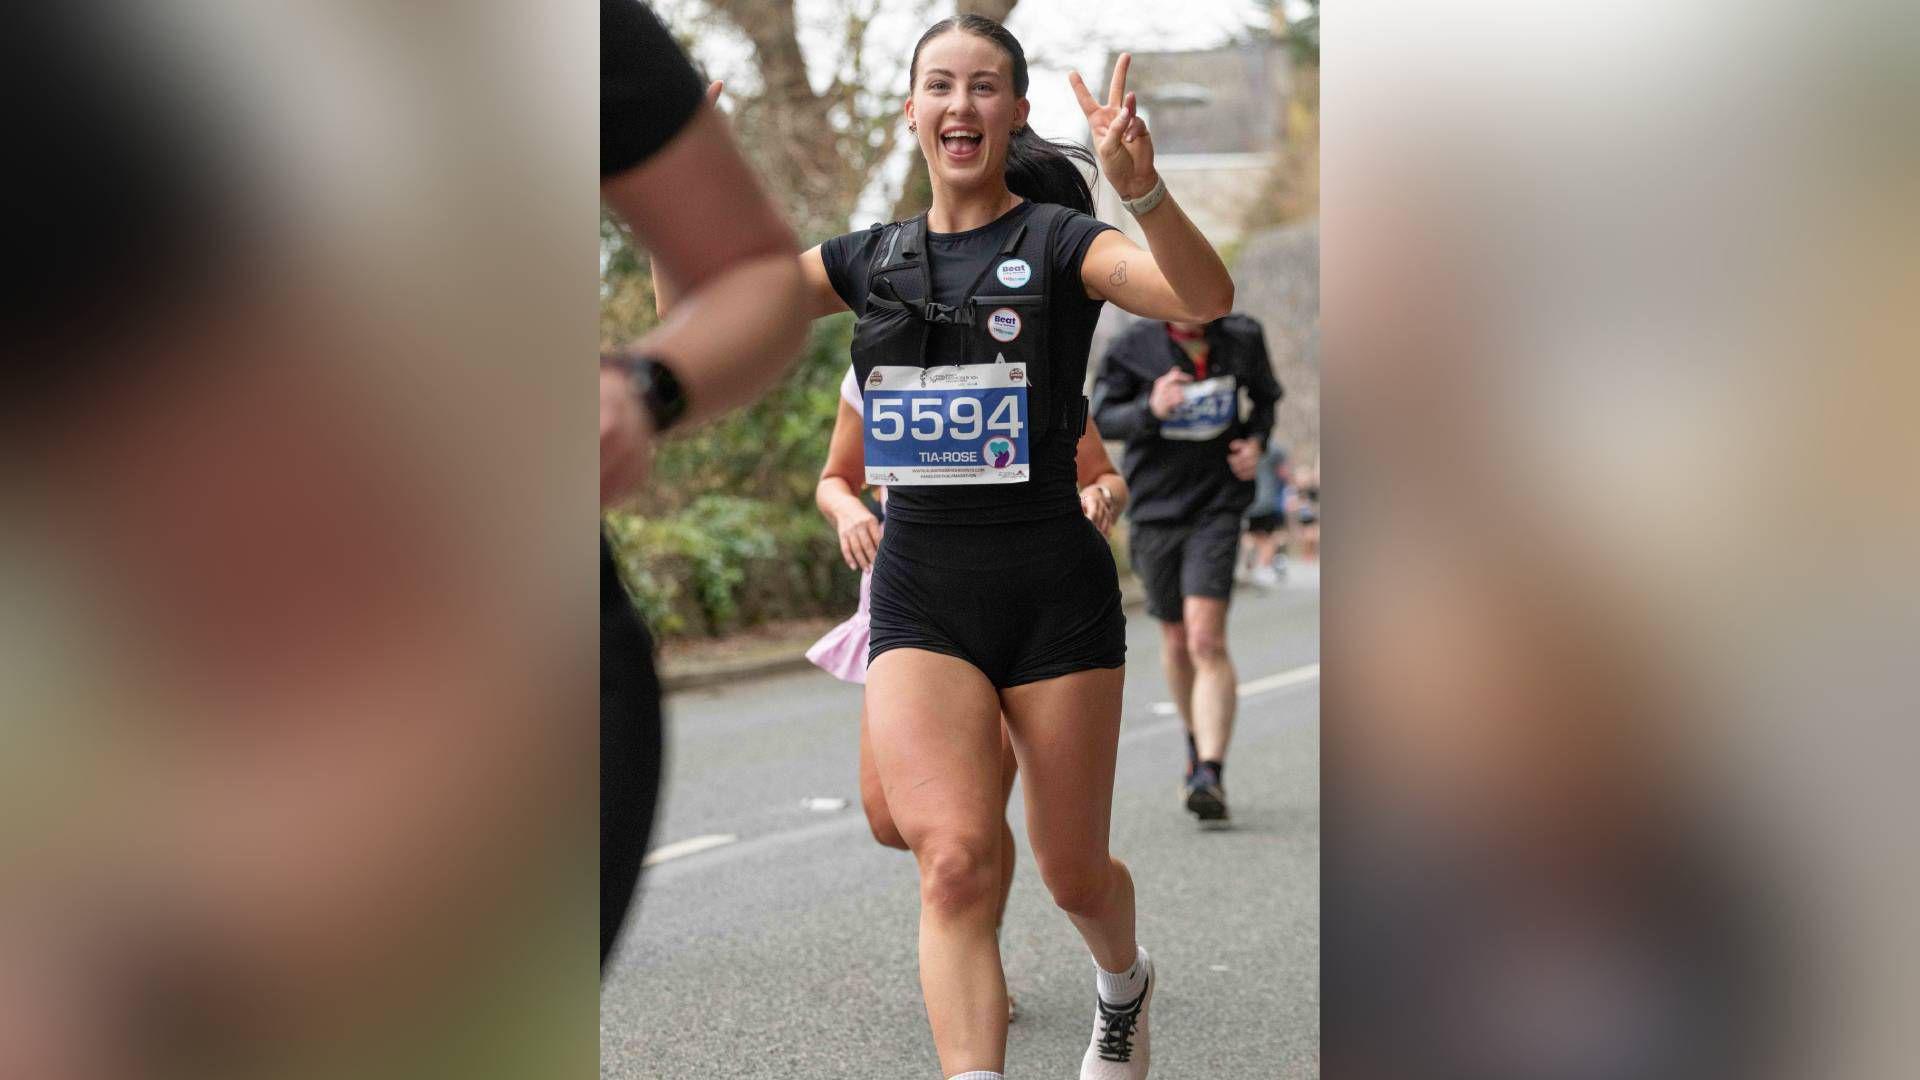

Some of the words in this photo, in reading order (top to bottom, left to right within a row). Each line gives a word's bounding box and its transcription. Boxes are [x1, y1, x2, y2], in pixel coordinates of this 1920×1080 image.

[1002, 264, 1026, 272] Beat
[994, 315, 1016, 325] Beat
[871, 395, 1024, 441] 5594
[918, 451, 977, 463] TIA-ROSE
